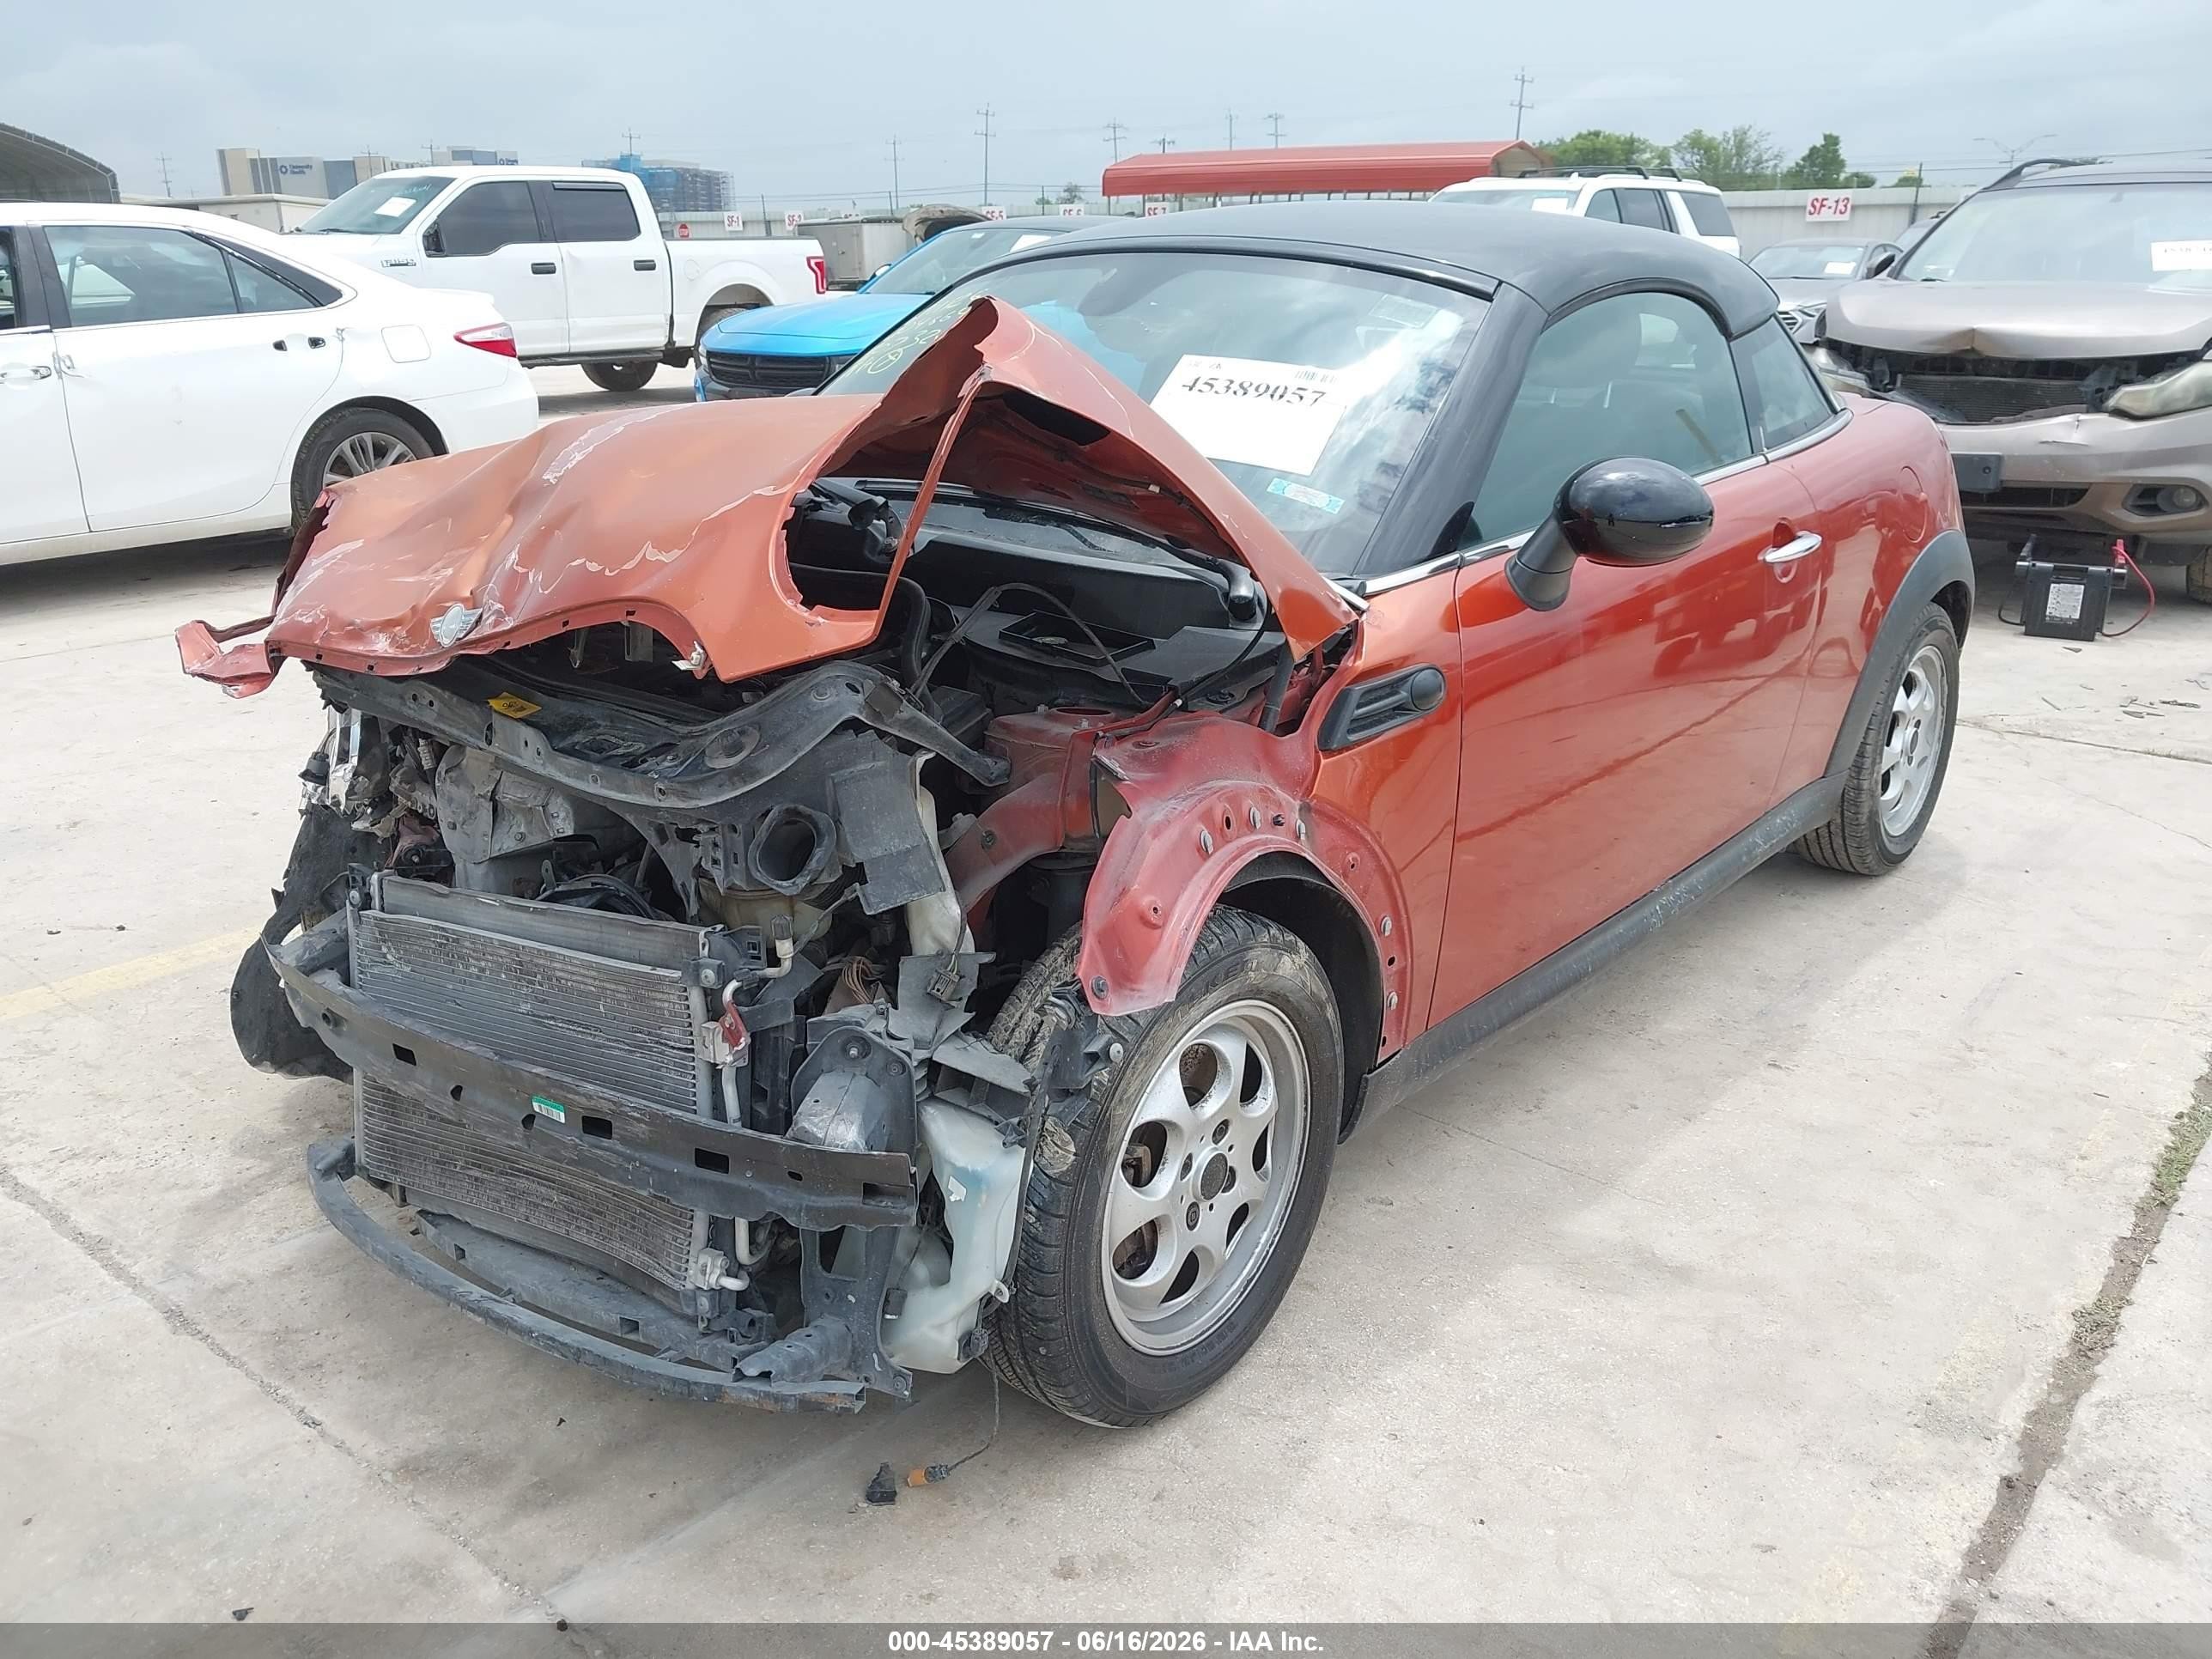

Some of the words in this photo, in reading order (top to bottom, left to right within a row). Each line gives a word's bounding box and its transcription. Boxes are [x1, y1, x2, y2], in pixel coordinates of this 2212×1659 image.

[1808, 197, 1850, 216] SF-13
[726, 215, 739, 227] SF-1
[1182, 376, 1327, 407] 45389057
